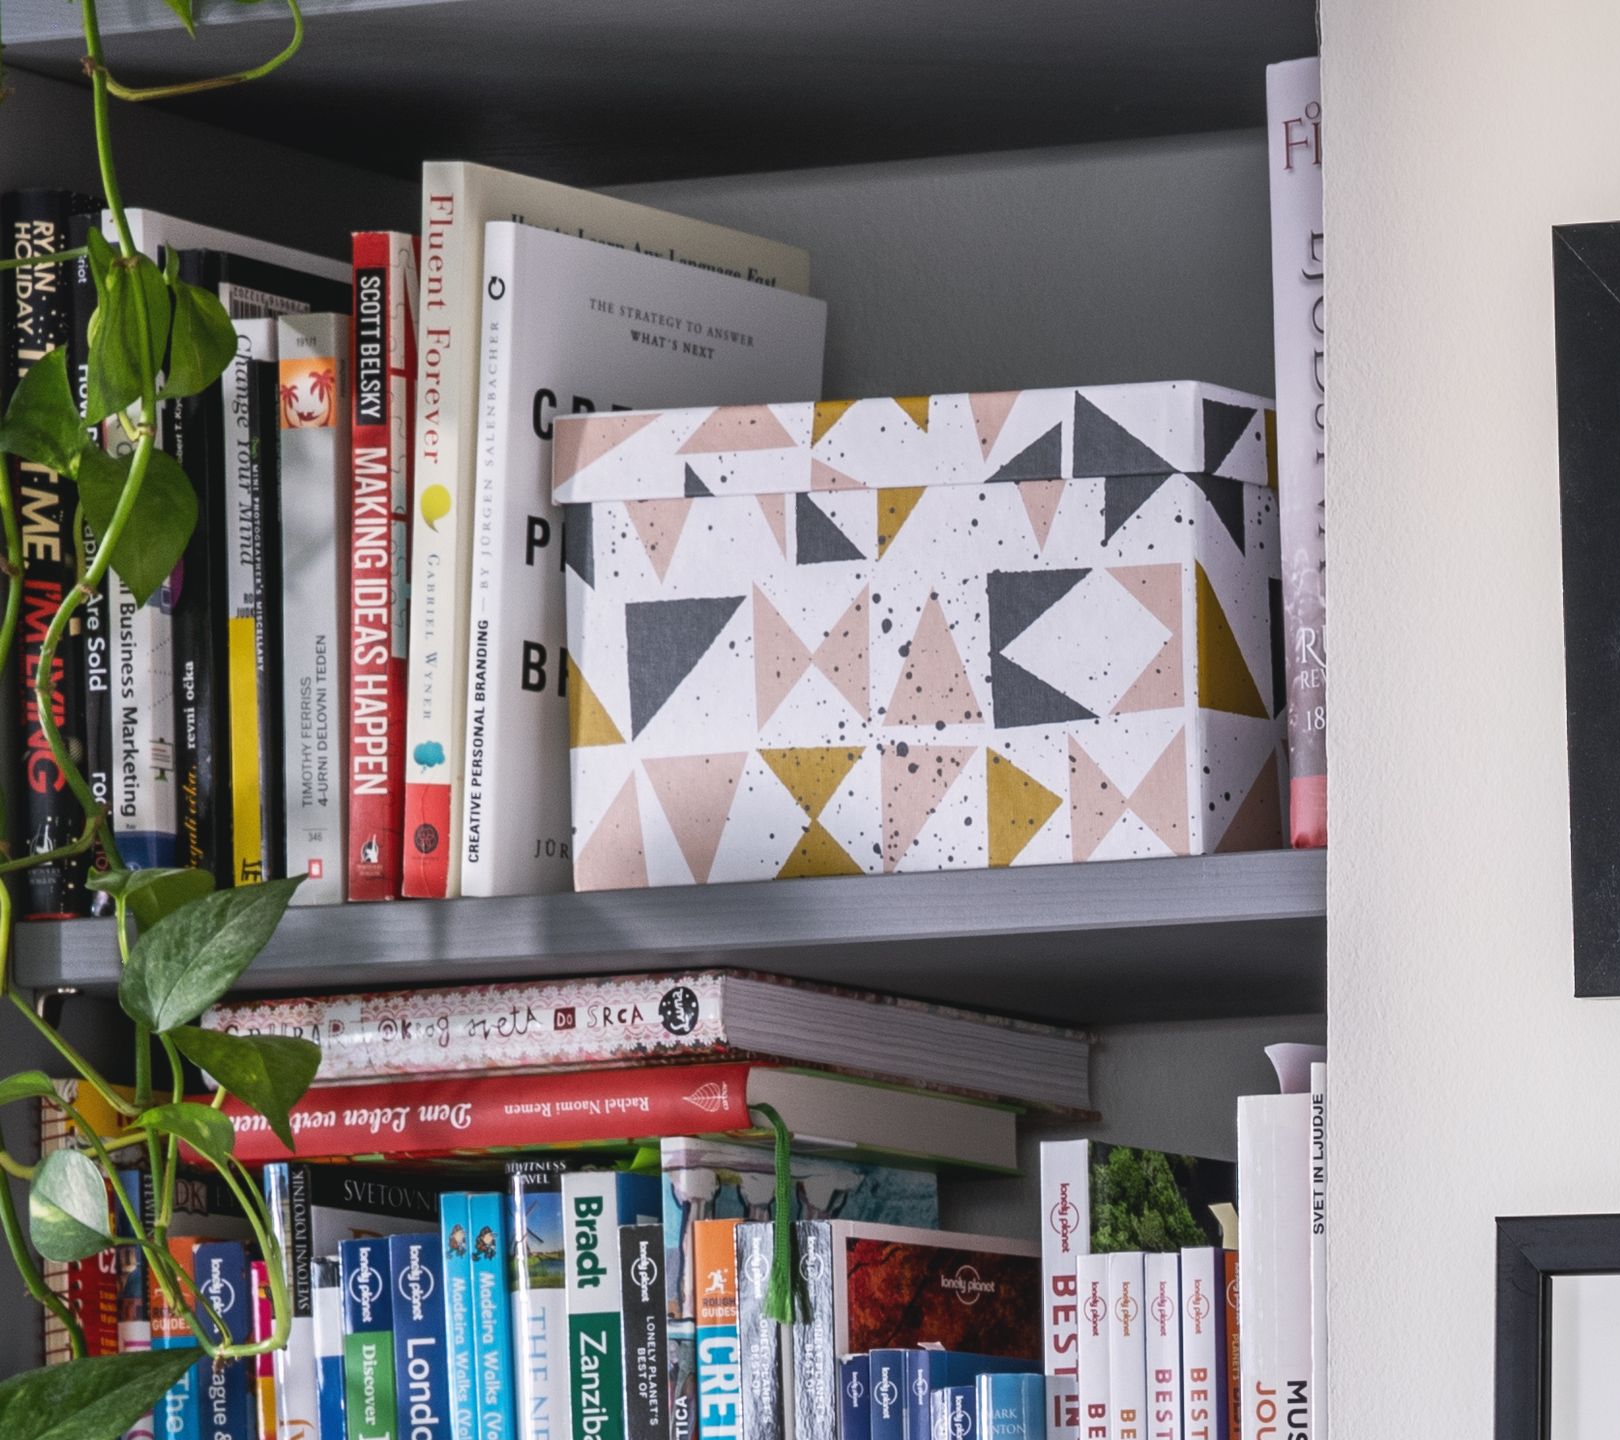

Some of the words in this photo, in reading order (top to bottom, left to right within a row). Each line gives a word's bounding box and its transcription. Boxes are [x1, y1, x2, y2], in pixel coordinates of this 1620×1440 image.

[428, 195, 453, 310] Fluent
[360, 276, 381, 337] SCOTT
[361, 344, 381, 418] BELSKY
[424, 326, 451, 464] Forever
[353, 447, 388, 570] MAKING
[353, 577, 388, 665] IDEAS
[475, 619, 488, 702] BRANDING
[353, 674, 388, 795] HAPPEN
[471, 706, 485, 786] PERSONAL
[468, 791, 481, 863] CREATIVE
[574, 1197, 602, 1289] Bradt
